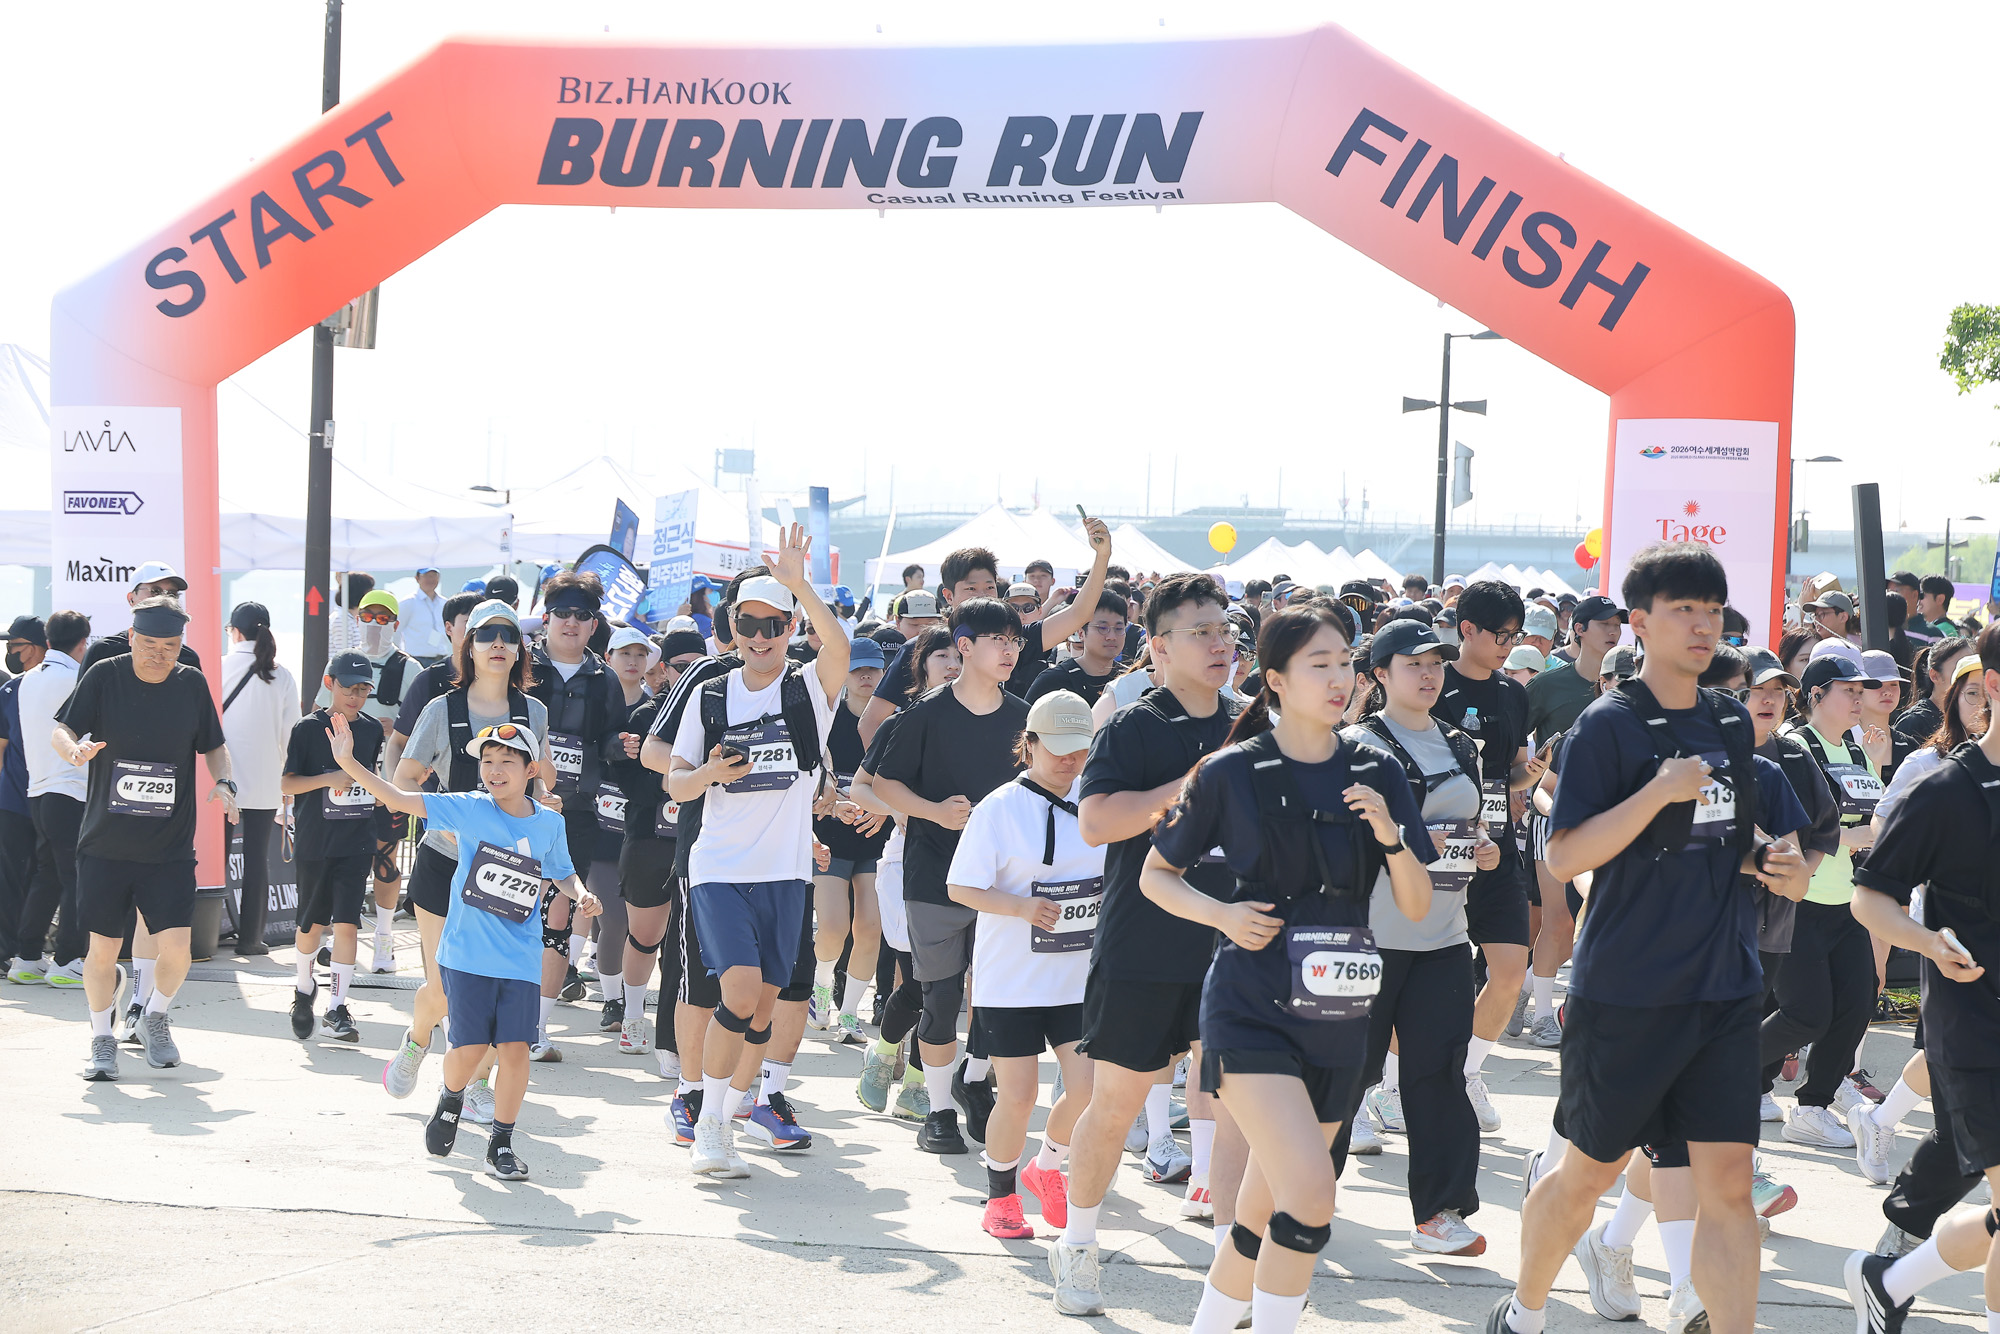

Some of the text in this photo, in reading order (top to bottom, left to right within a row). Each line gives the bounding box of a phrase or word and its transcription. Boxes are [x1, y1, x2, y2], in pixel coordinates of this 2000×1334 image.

[537, 111, 1204, 188] BURNING RUN
[867, 188, 1185, 205] Casual Running Festival
[144, 111, 406, 318] START
[1325, 107, 1651, 332] FINISH
[1670, 445, 1750, 456] 2026여수세계섬박람회
[67, 497, 128, 509] FAVONEX
[653, 521, 695, 556] 정근식
[1656, 519, 1727, 547] Tage
[649, 560, 692, 588] 민주진보
[750, 731, 764, 739] RUN
[552, 750, 581, 765] 7035
[751, 748, 792, 762] 7281
[123, 781, 173, 794] M 7293
[1853, 779, 1880, 790] 7542
[603, 800, 612, 808] W
[668, 806, 678, 814] W
[1480, 800, 1506, 812] 7205
[481, 846, 510, 860] BURNING
[509, 856, 523, 864] RUN
[1442, 845, 1475, 860] 7843
[483, 871, 538, 897] M 7276
[1036, 884, 1080, 893] BURNING RUN
[1063, 900, 1102, 920] 8026
[1292, 932, 1351, 942] BURNING RUN
[1311, 961, 1380, 981] W 7660
[440, 1111, 458, 1123] NIKE
